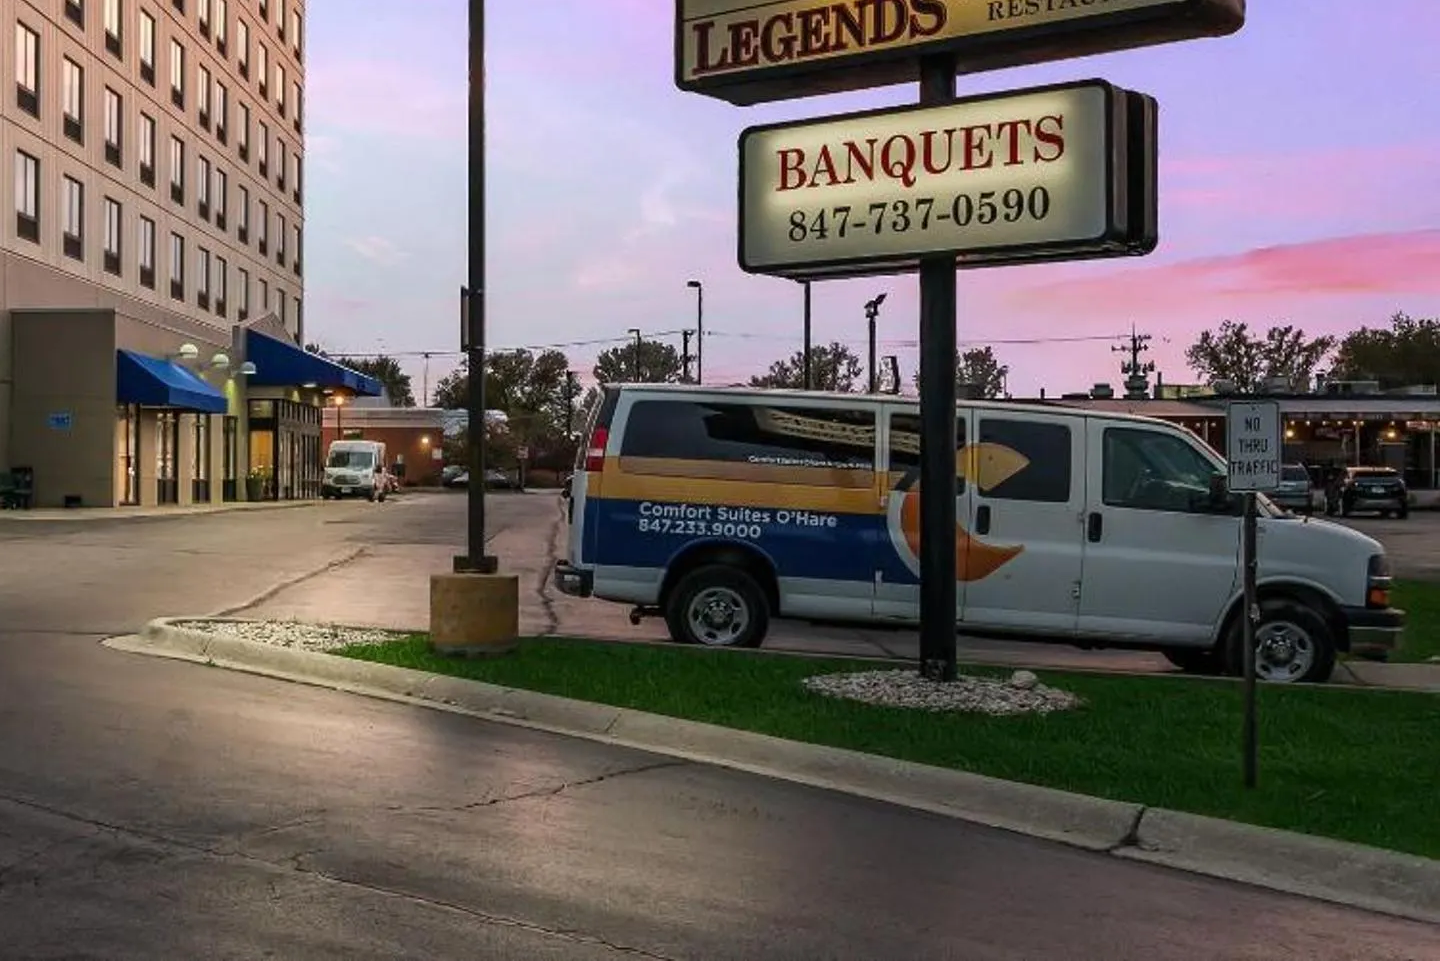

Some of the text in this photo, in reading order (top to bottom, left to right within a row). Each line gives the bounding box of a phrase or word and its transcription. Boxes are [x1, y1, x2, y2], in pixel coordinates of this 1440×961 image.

[775, 114, 1065, 192] BANQUETS
[788, 186, 1050, 242] 847-737-0590
[1245, 417, 1261, 432] NO
[1238, 438, 1268, 453] THRU
[1231, 460, 1279, 476] TRAFFIC
[639, 501, 838, 528] Comfort Suites O'Hare
[638, 518, 761, 539] 847.233.9000
